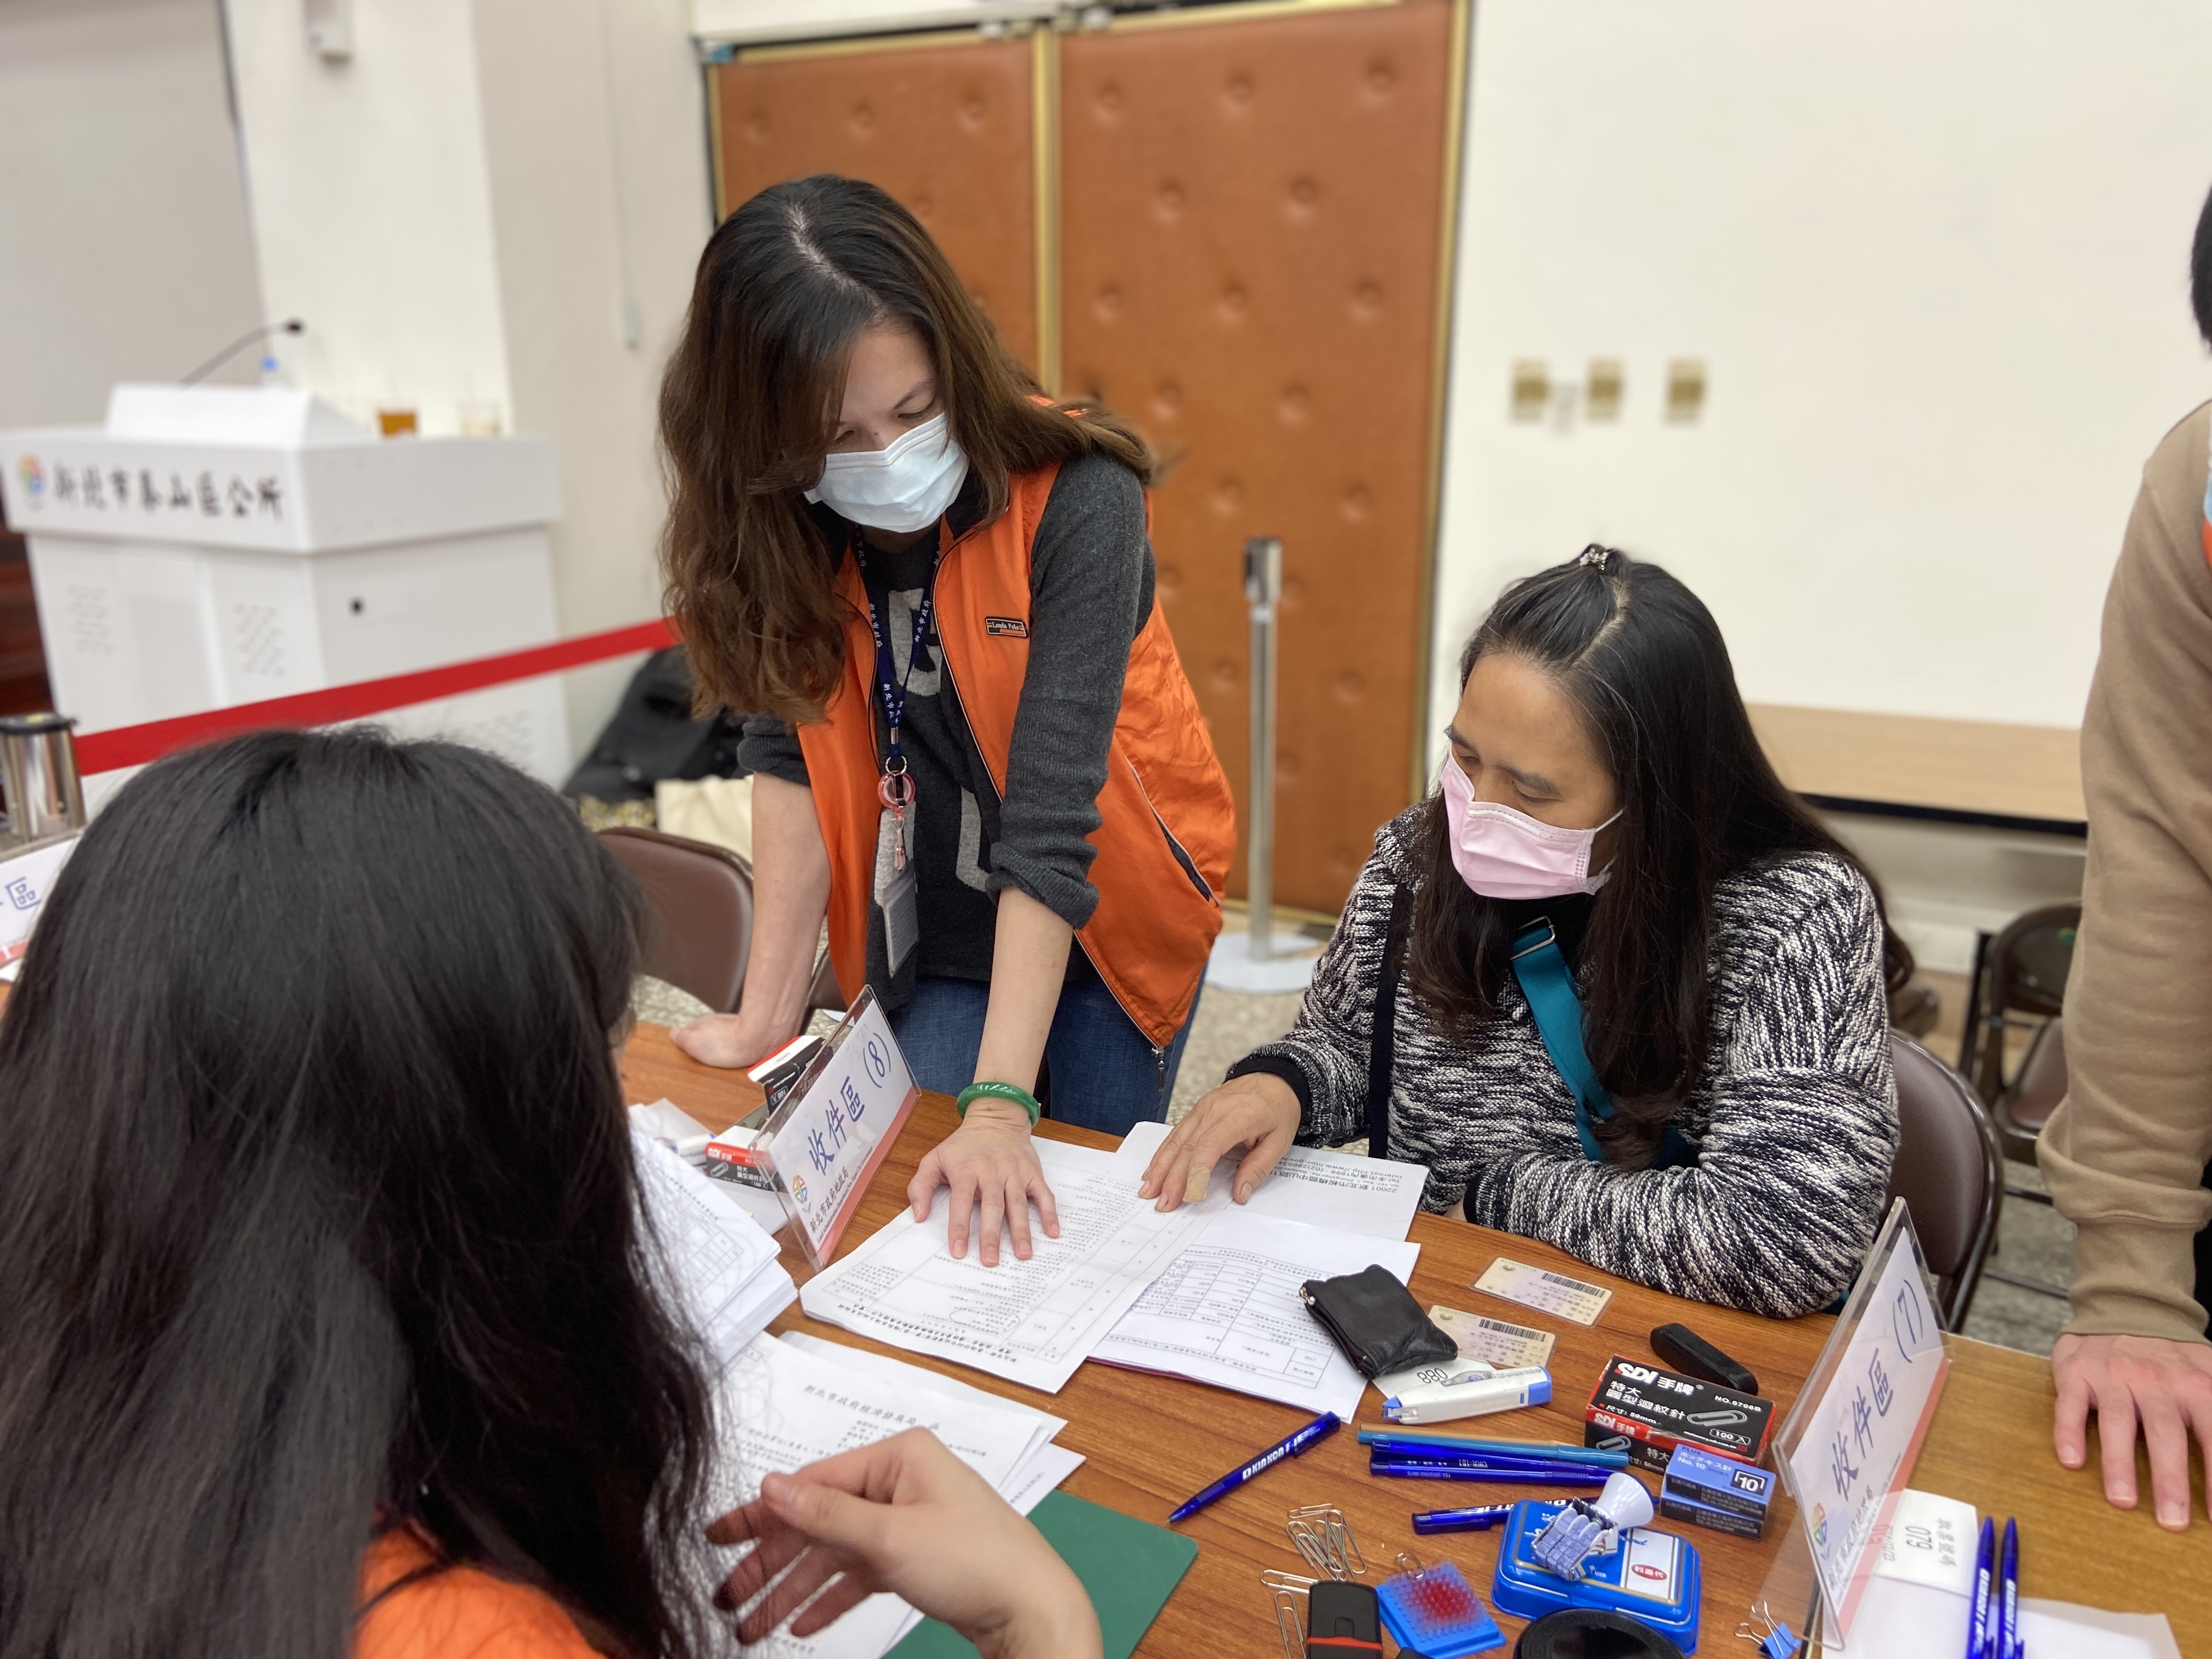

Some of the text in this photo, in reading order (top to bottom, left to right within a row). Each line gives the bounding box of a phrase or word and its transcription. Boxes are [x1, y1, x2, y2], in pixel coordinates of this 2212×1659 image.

[0, 877, 41, 911] 區
[808, 1075, 866, 1176] 收件區
[809, 1165, 849, 1234] 新北市政府地政局
[1617, 1362, 1659, 1385] SDI
[1657, 1376, 1694, 1396] 手牌
[1610, 1380, 1642, 1397] 特大
[1594, 1413, 1616, 1428] SDI
[1629, 1412, 1657, 1424] 50mm
[1832, 1347, 1894, 1502] 收件區
[1715, 1430, 1734, 1440] 100
[1647, 1447, 1671, 1463] 特大
[1682, 1446, 1701, 1455] PLUS
[1739, 1476, 1759, 1492] 10
[1905, 1525, 1933, 1550] 079
